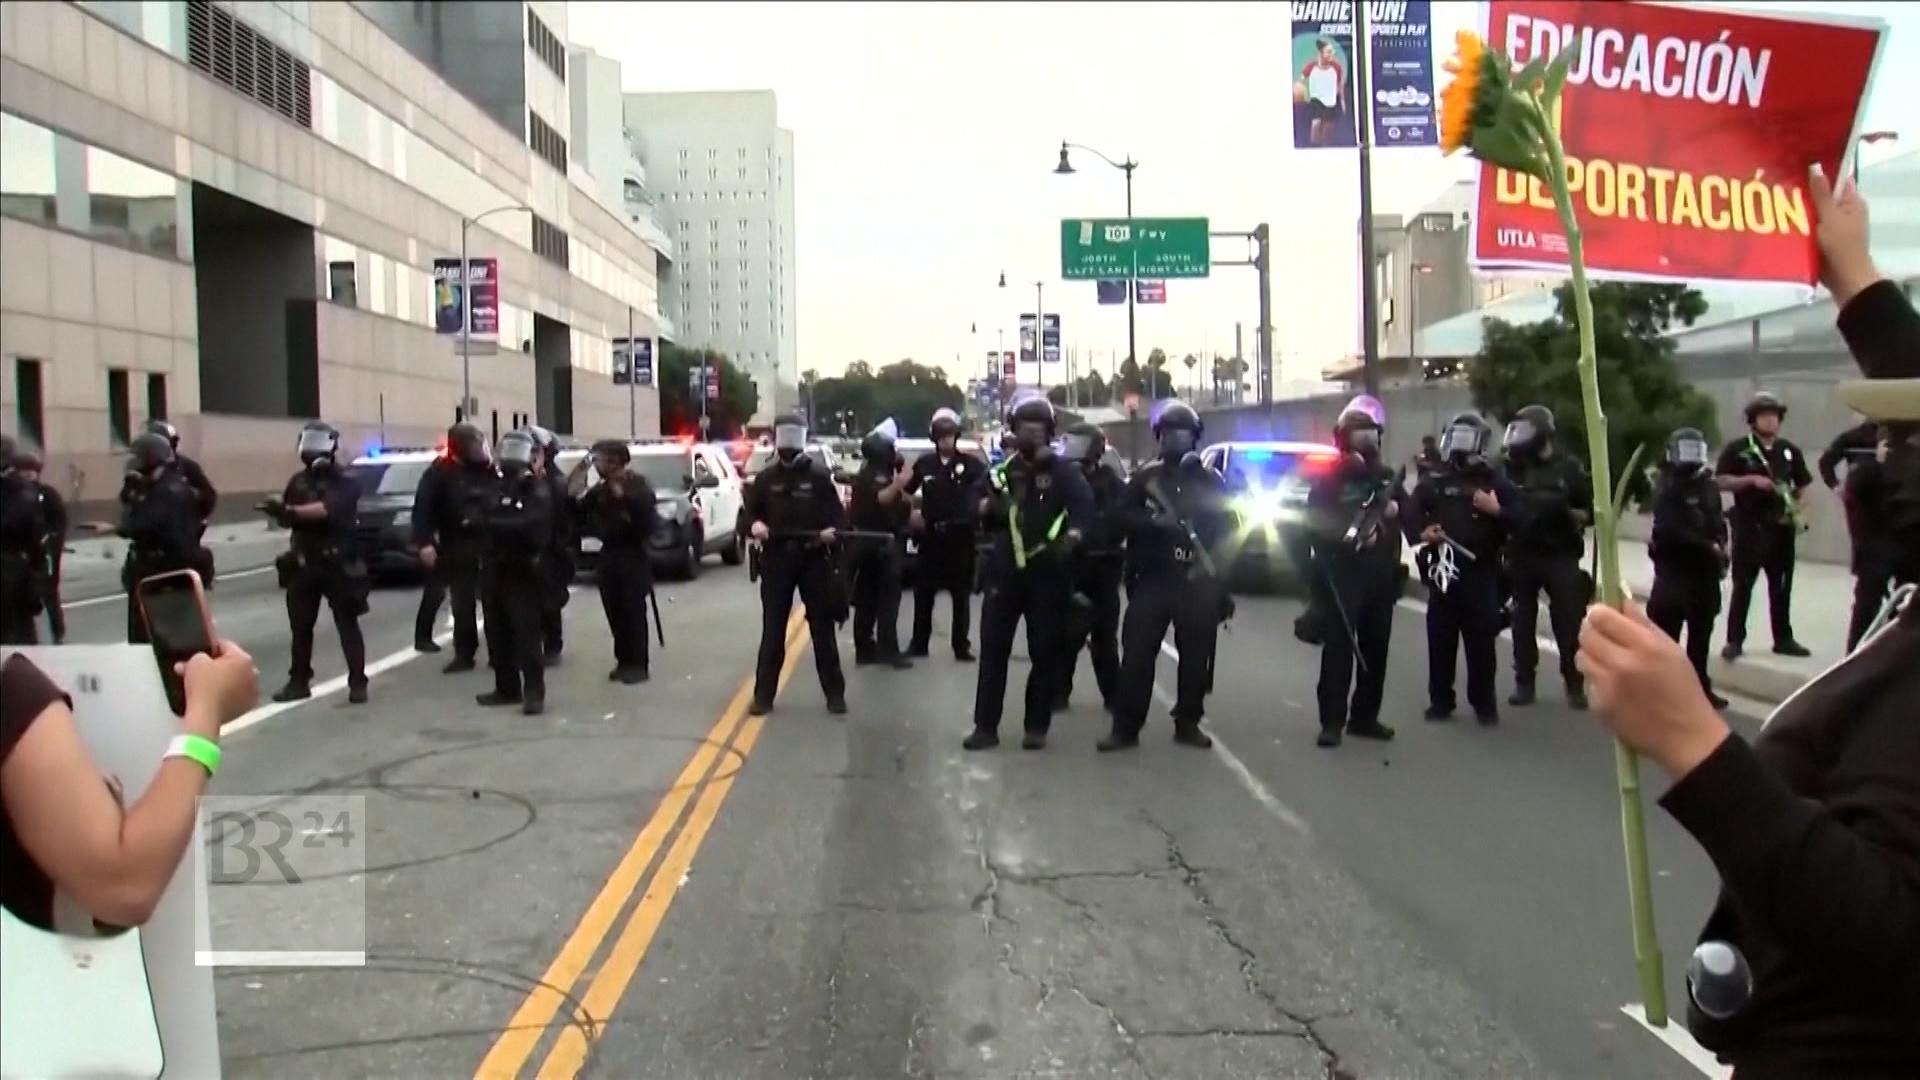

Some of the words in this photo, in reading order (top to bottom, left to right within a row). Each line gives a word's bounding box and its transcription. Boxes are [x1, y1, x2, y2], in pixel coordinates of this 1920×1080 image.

[1292, 1, 1350, 20] GAME
[1372, 1, 1407, 21] ON!
[1506, 14, 1773, 108] EDUCACIÓN
[1139, 229, 1166, 240] Fwy
[1497, 228, 1536, 248] UTLA
